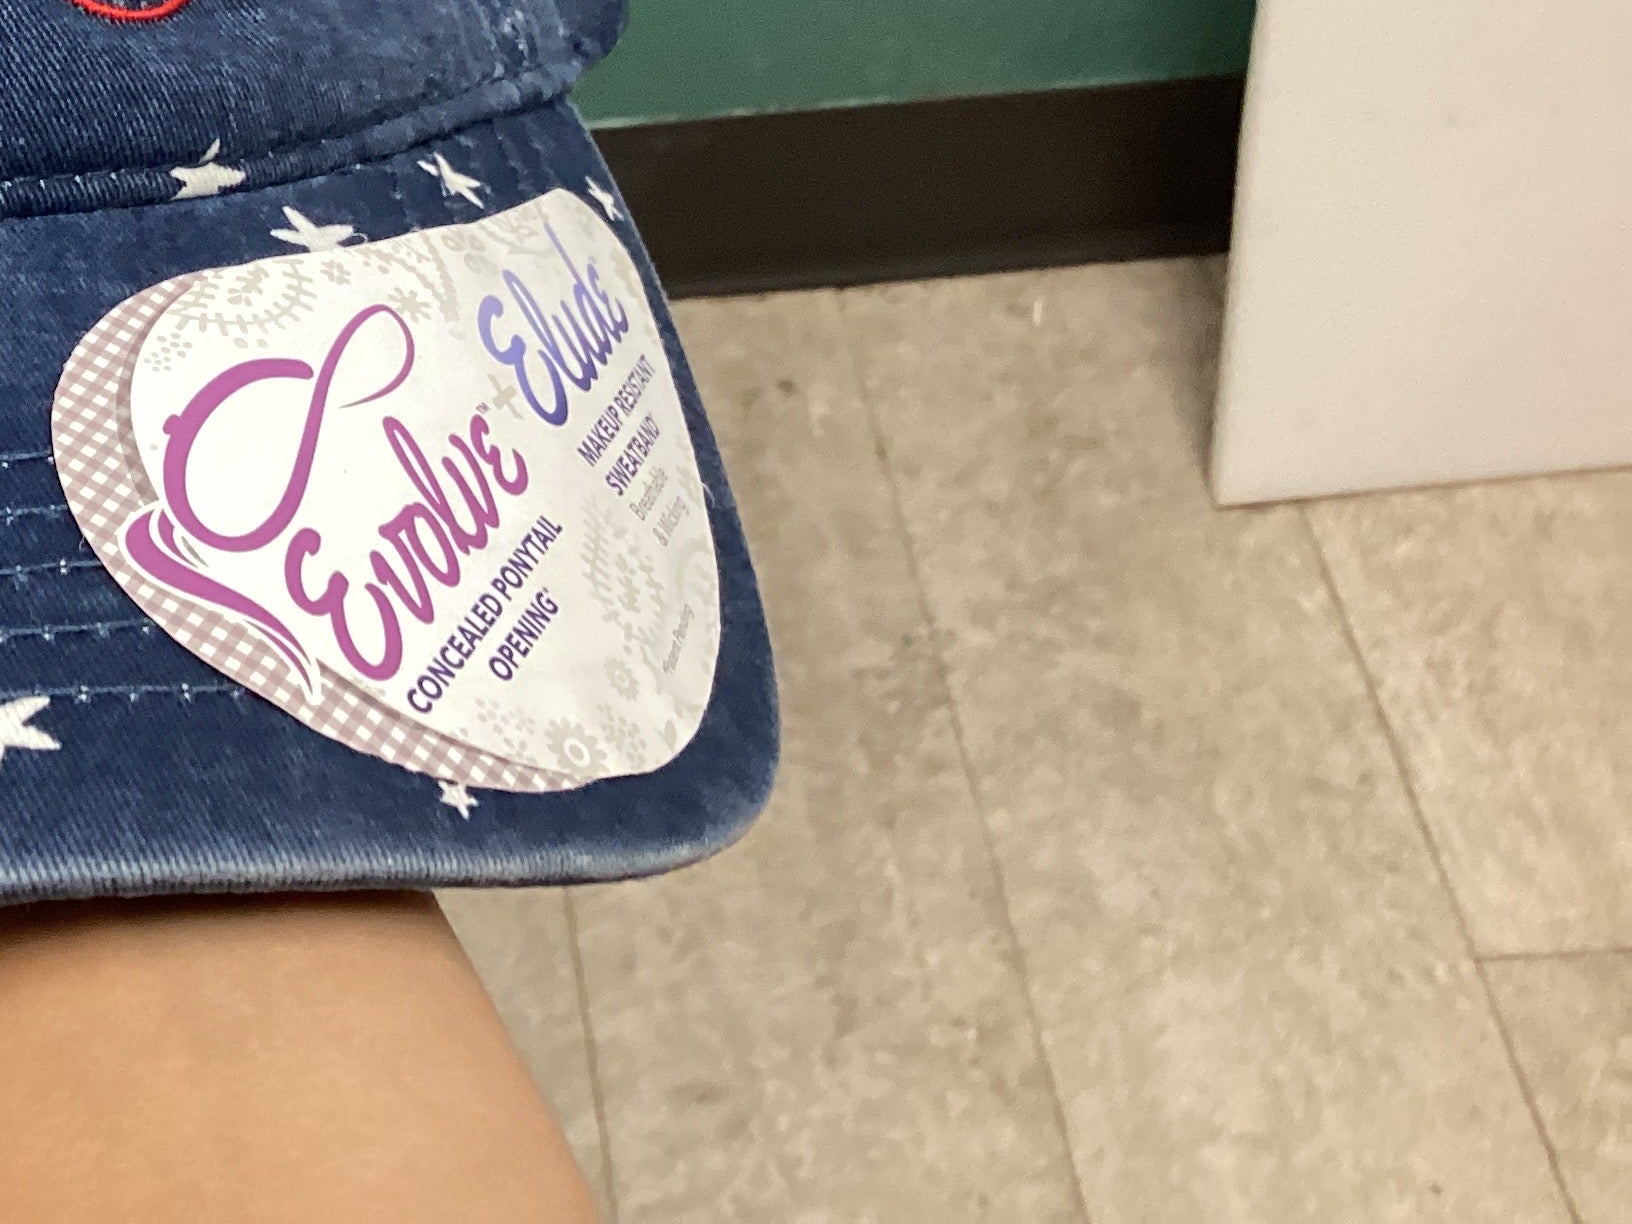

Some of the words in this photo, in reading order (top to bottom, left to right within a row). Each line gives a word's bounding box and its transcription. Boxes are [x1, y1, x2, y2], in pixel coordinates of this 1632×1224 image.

[478, 223, 628, 426] Elude
[577, 405, 623, 467] MAKEUP
[613, 354, 655, 417] RESISTANT
[605, 415, 660, 496] SWEATBAND
[407, 593, 503, 713] CONCEALED
[491, 515, 563, 602] PONYTAIL
